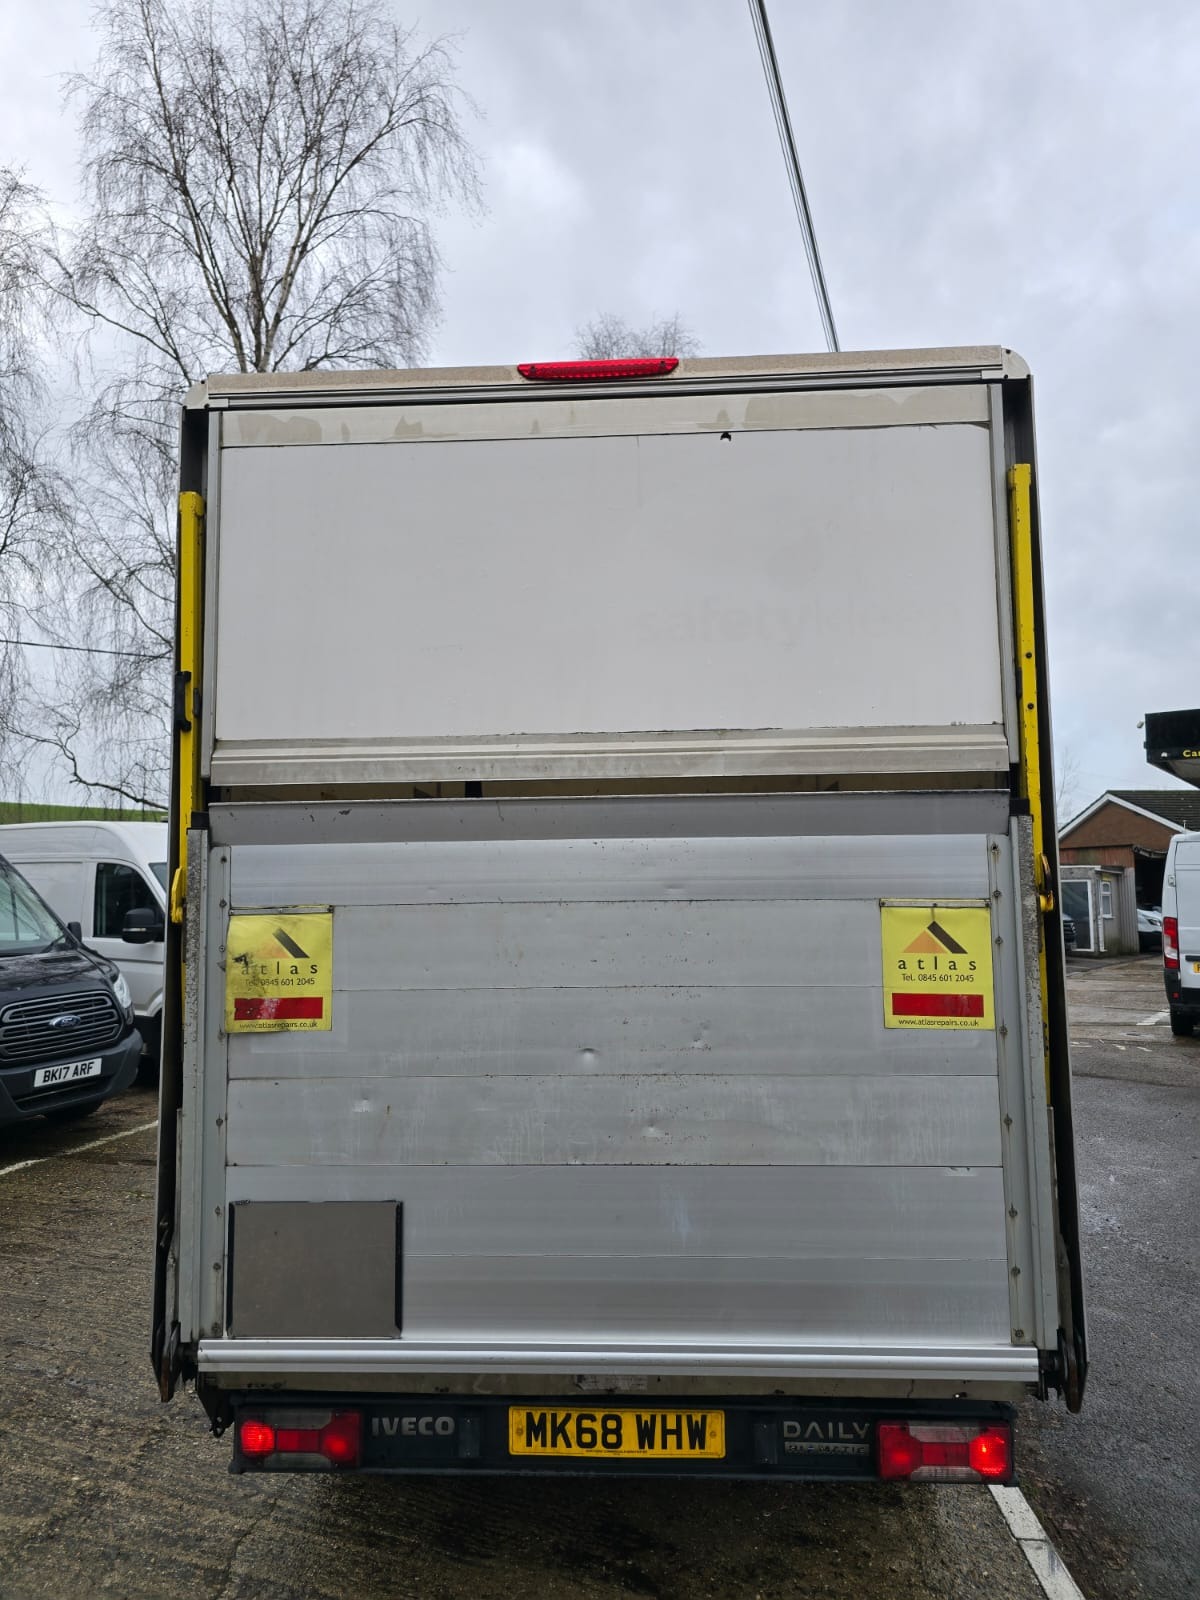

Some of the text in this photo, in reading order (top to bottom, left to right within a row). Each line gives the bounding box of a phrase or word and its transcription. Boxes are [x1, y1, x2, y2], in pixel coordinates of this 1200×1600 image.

[241, 961, 319, 976] atlas
[898, 956, 977, 971] atlas
[260, 978, 279, 986] 0845
[281, 978, 294, 986] 601
[296, 977, 315, 986] 2045
[901, 973, 974, 983] Tel. 0845 601 2045
[898, 1018, 979, 1027] www.atlasrepairs.co.uk
[42, 1061, 95, 1083] BK17 ARF
[371, 1416, 456, 1436] IVECO
[525, 1412, 708, 1450] MK68 WHW
[783, 1421, 870, 1440] DAILY
